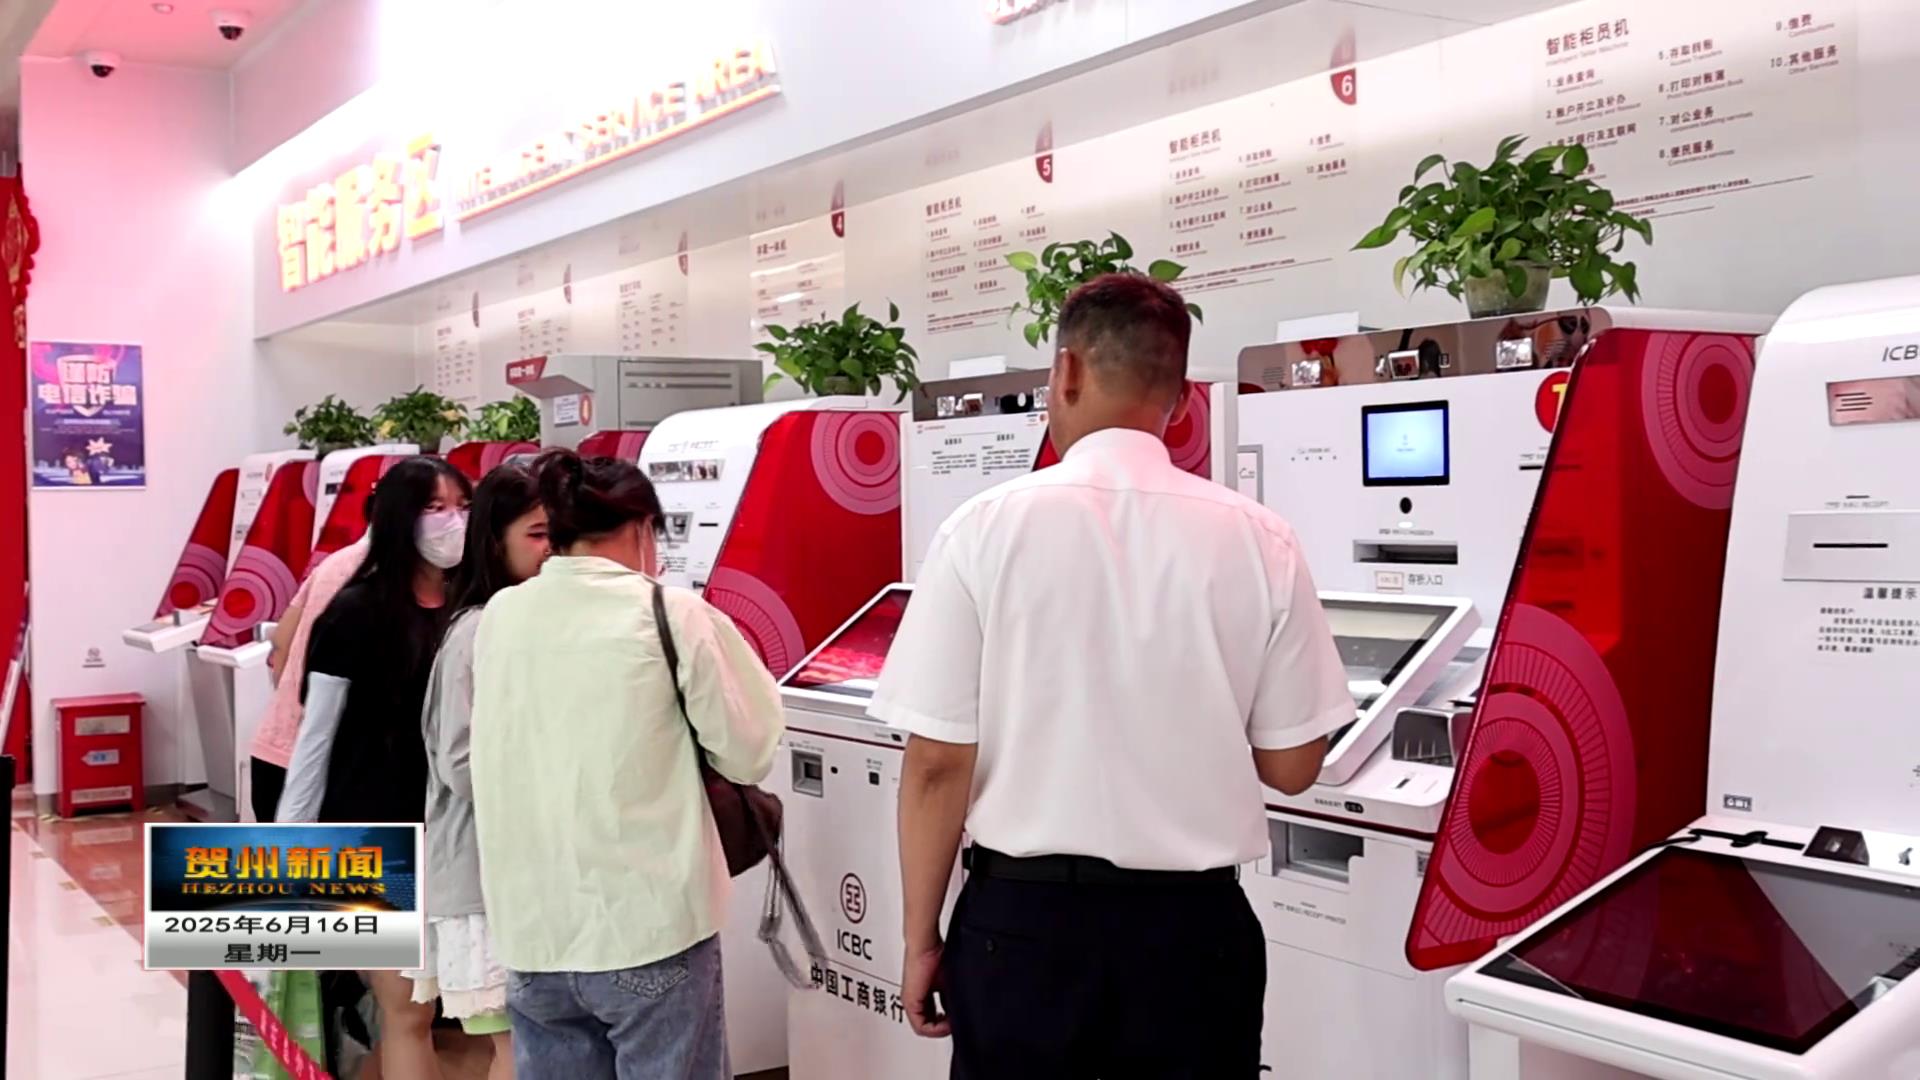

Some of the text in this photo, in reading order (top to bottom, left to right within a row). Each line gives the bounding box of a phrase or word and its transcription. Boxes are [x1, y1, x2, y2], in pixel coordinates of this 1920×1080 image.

[1547, 18, 1629, 56] 智能柜员机
[1341, 74, 1354, 97] 6
[1042, 158, 1051, 176] 5
[276, 134, 444, 293] 智能服务区
[1882, 344, 1920, 362] ICB
[37, 383, 138, 406] 电信诈骗
[837, 928, 873, 961] ICBC
[810, 961, 905, 1024] 中国工商银行
